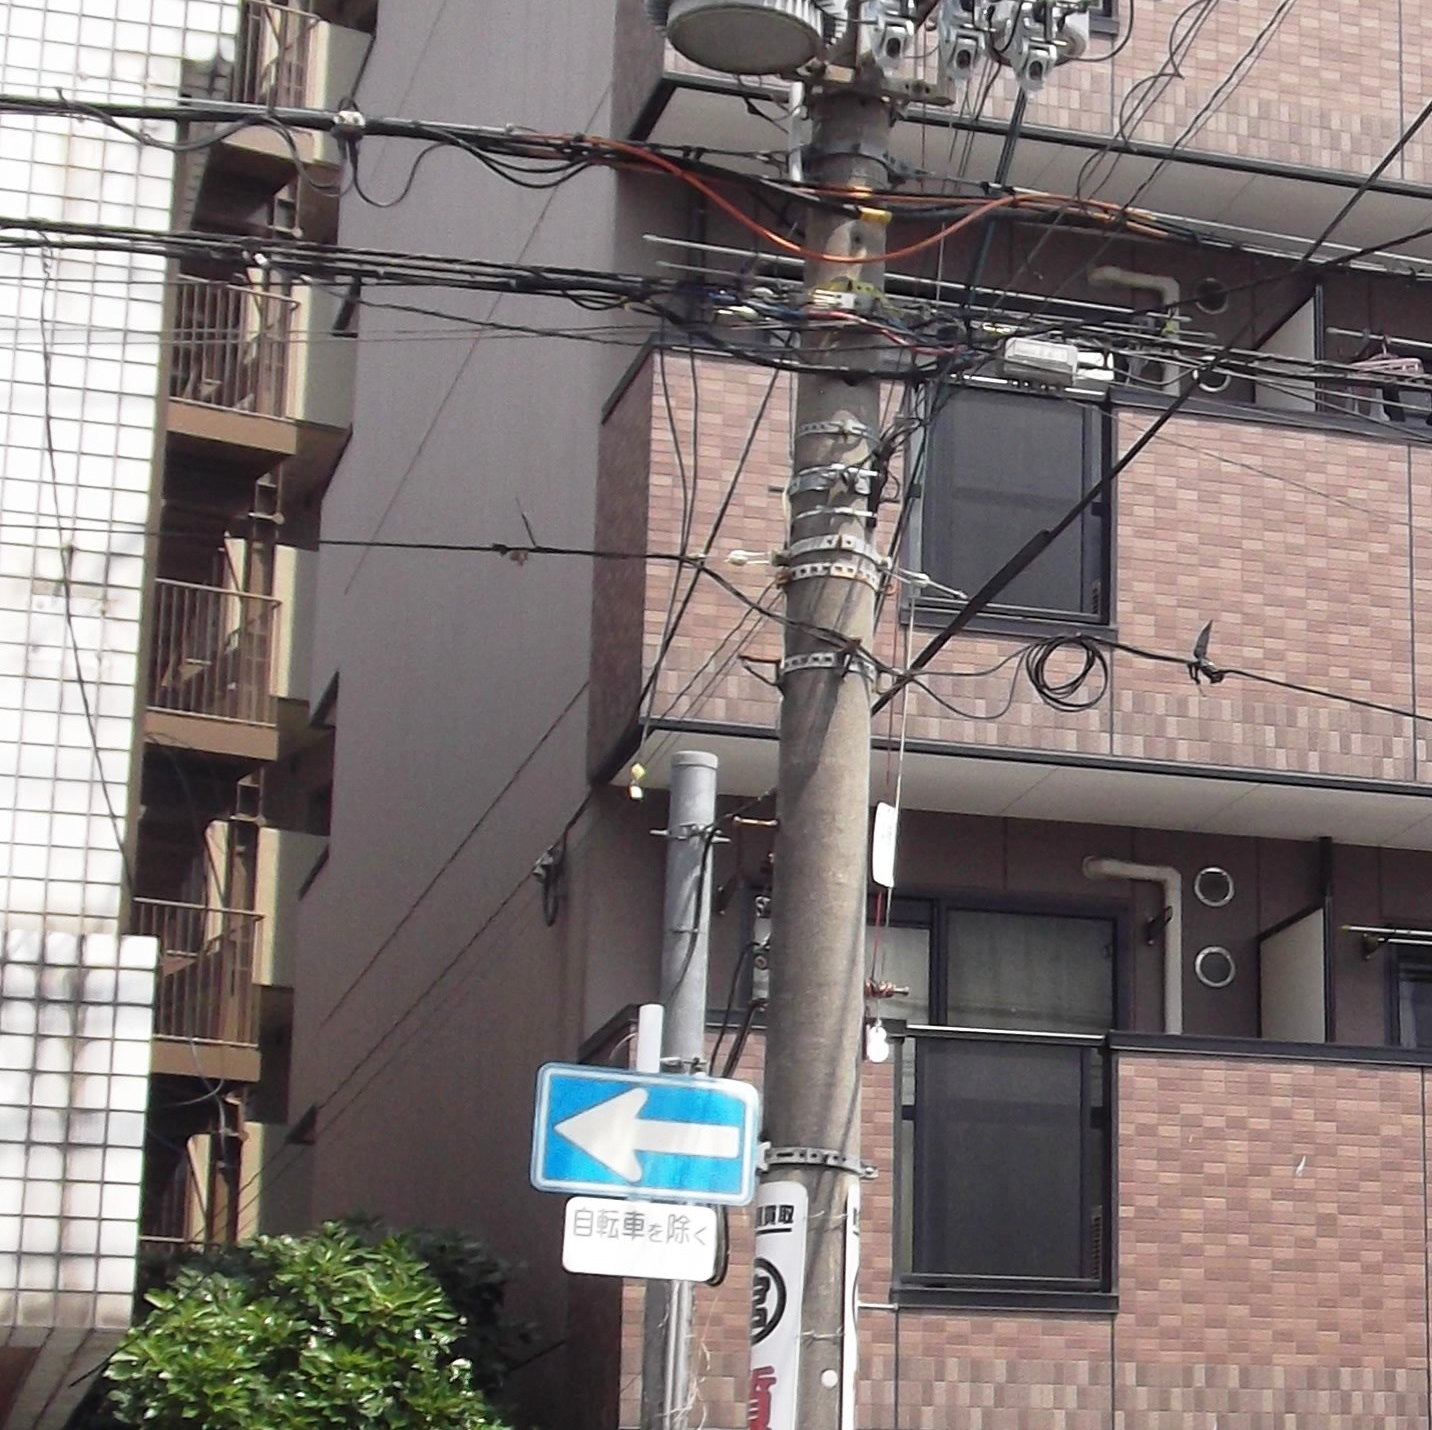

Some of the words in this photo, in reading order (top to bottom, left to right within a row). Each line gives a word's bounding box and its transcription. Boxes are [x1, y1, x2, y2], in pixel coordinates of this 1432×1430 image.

[573, 1206, 707, 1246] 自転車を除く
